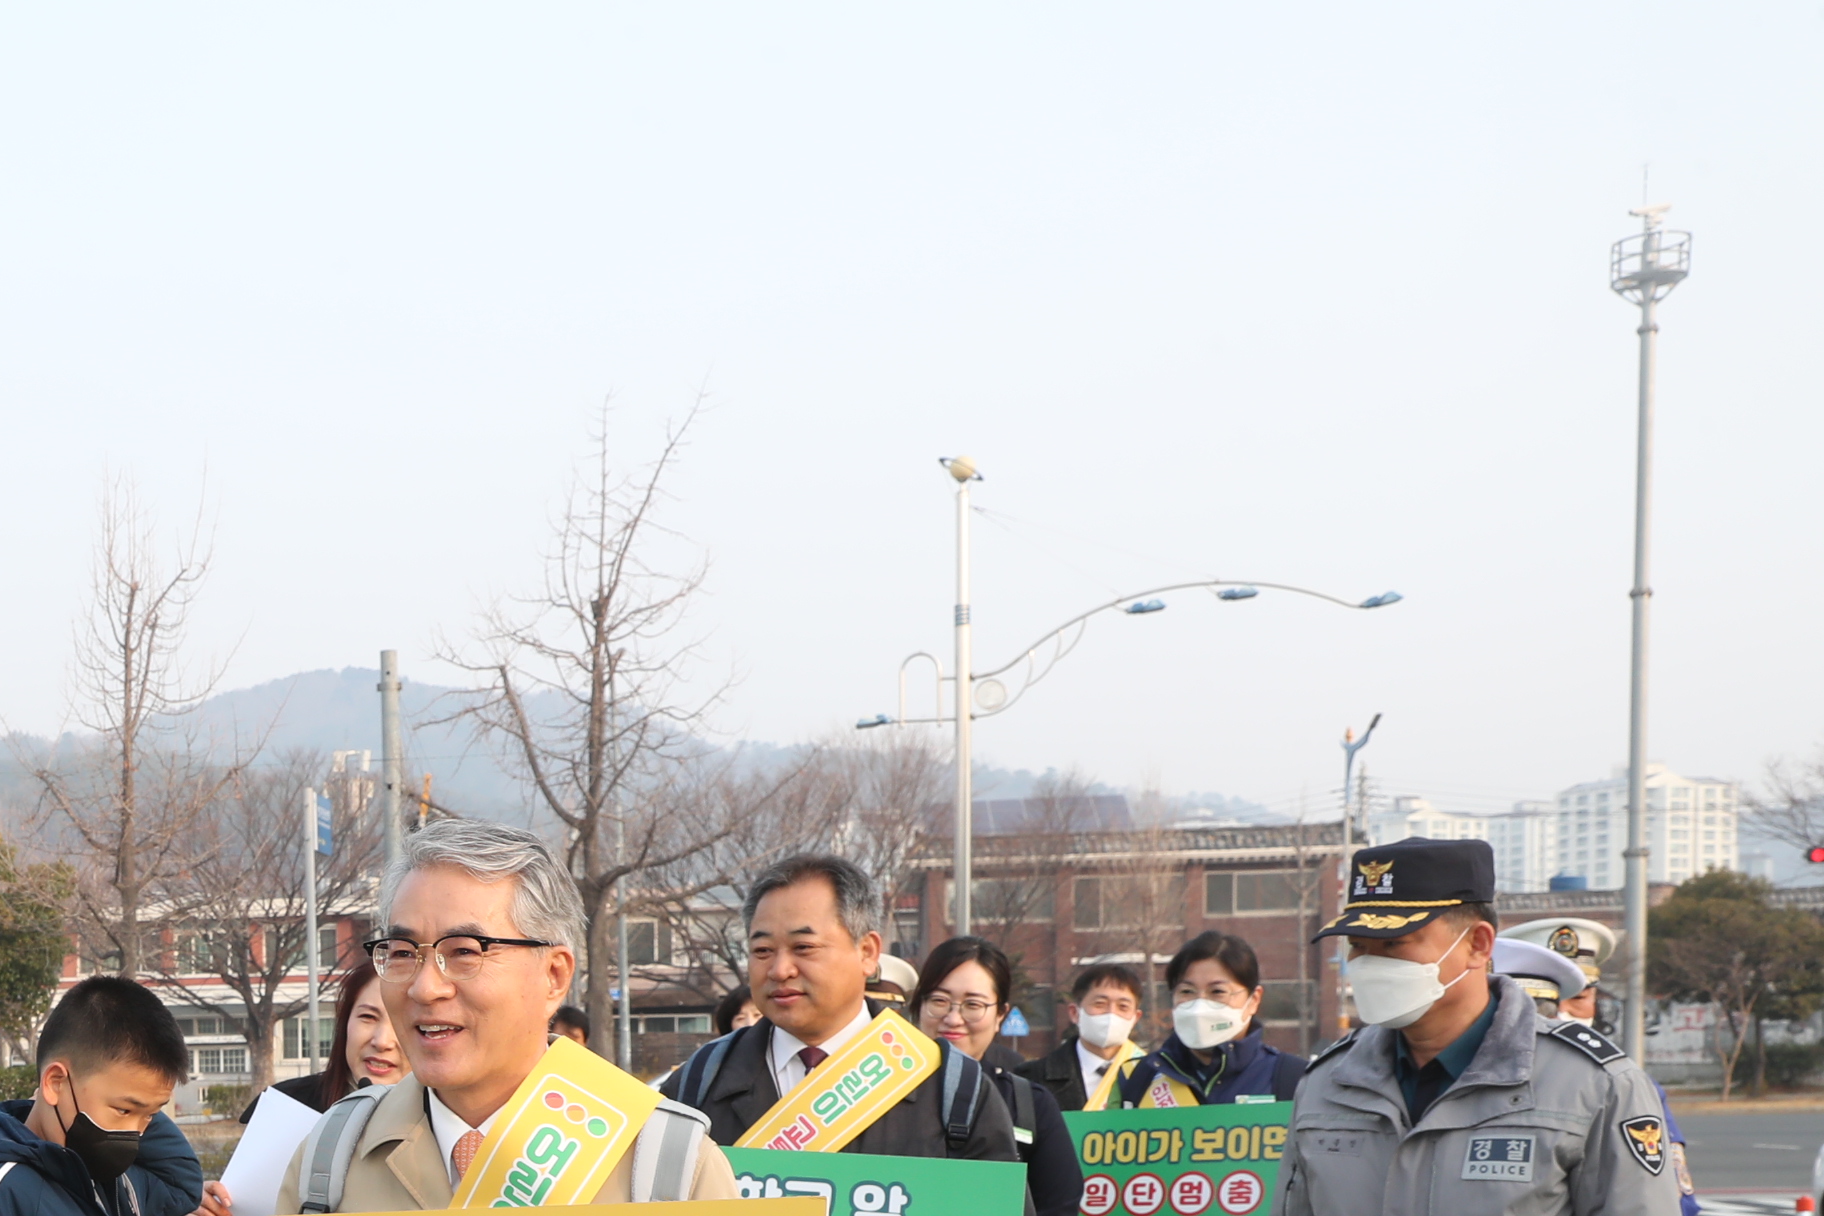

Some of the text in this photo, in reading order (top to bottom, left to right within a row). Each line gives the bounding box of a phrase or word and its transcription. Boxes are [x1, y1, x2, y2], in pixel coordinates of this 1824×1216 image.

[812, 1053, 892, 1126] 어린이
[1082, 1125, 1289, 1164] 아이가 보이면
[490, 1126, 578, 1208] 어린
[1469, 1165, 1526, 1176] POLICE
[1085, 1179, 1254, 1207] 일 단 멈 춤
